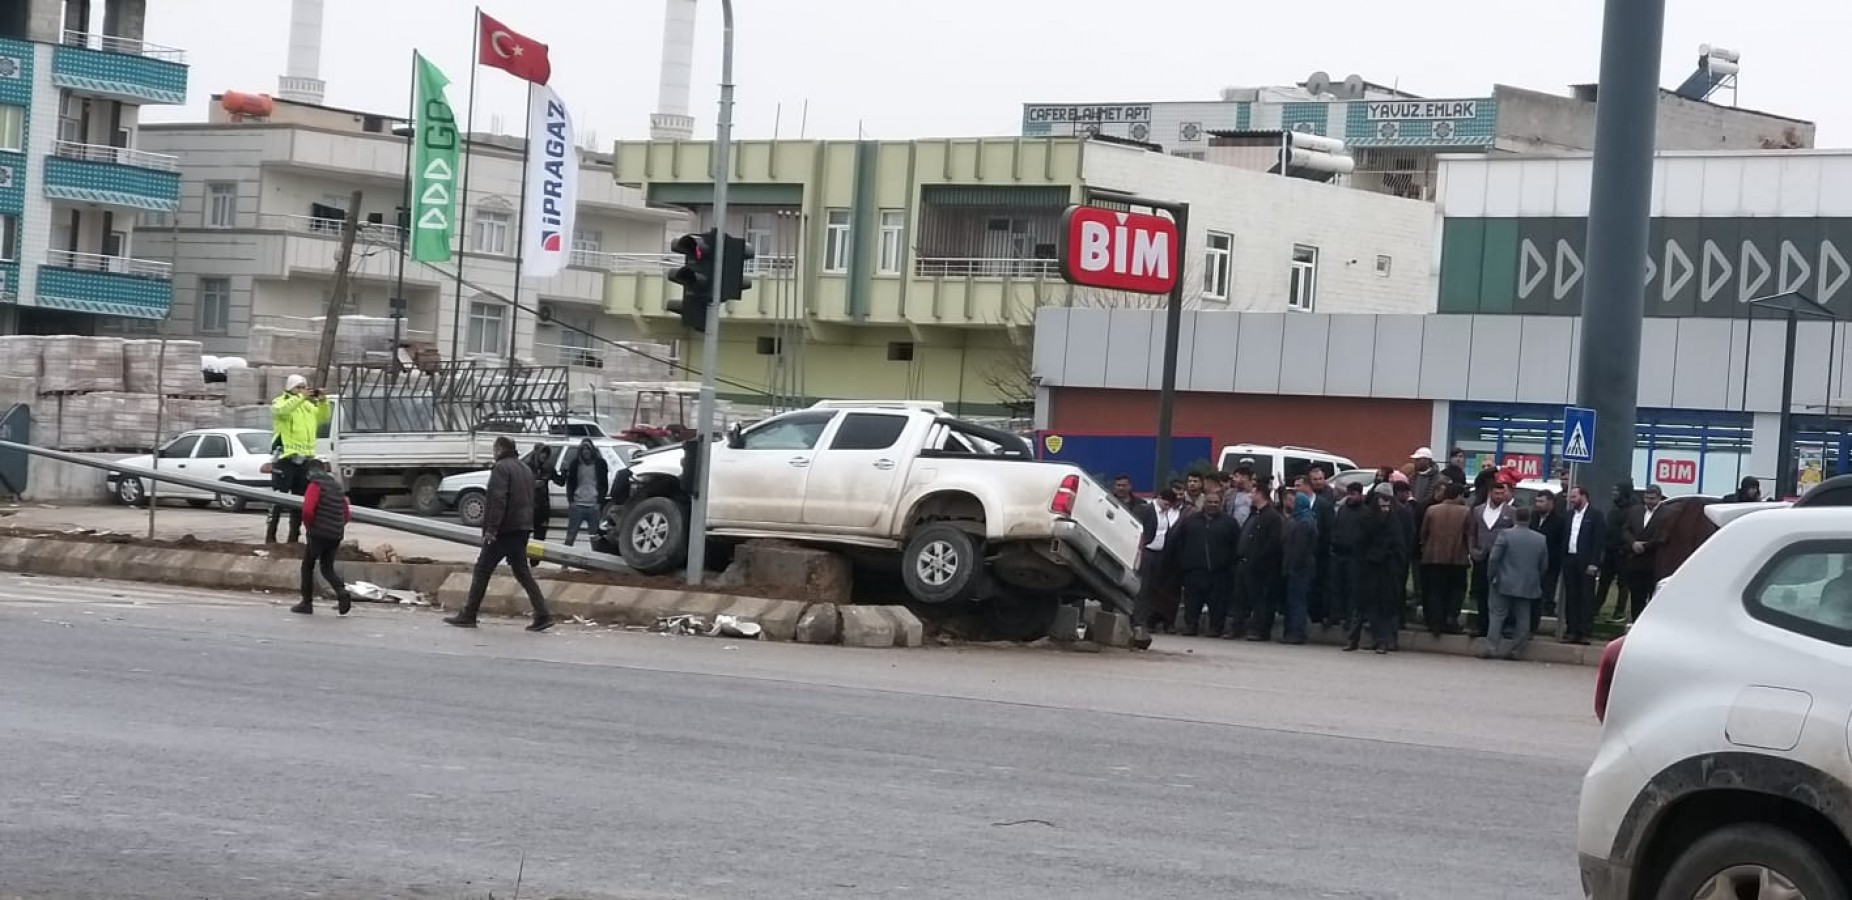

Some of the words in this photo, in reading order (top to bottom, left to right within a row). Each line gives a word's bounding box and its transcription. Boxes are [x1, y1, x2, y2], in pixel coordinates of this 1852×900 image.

[1030, 108, 1067, 121] CAFER
[1125, 107, 1149, 120] APT
[1081, 212, 1169, 280] BİM
